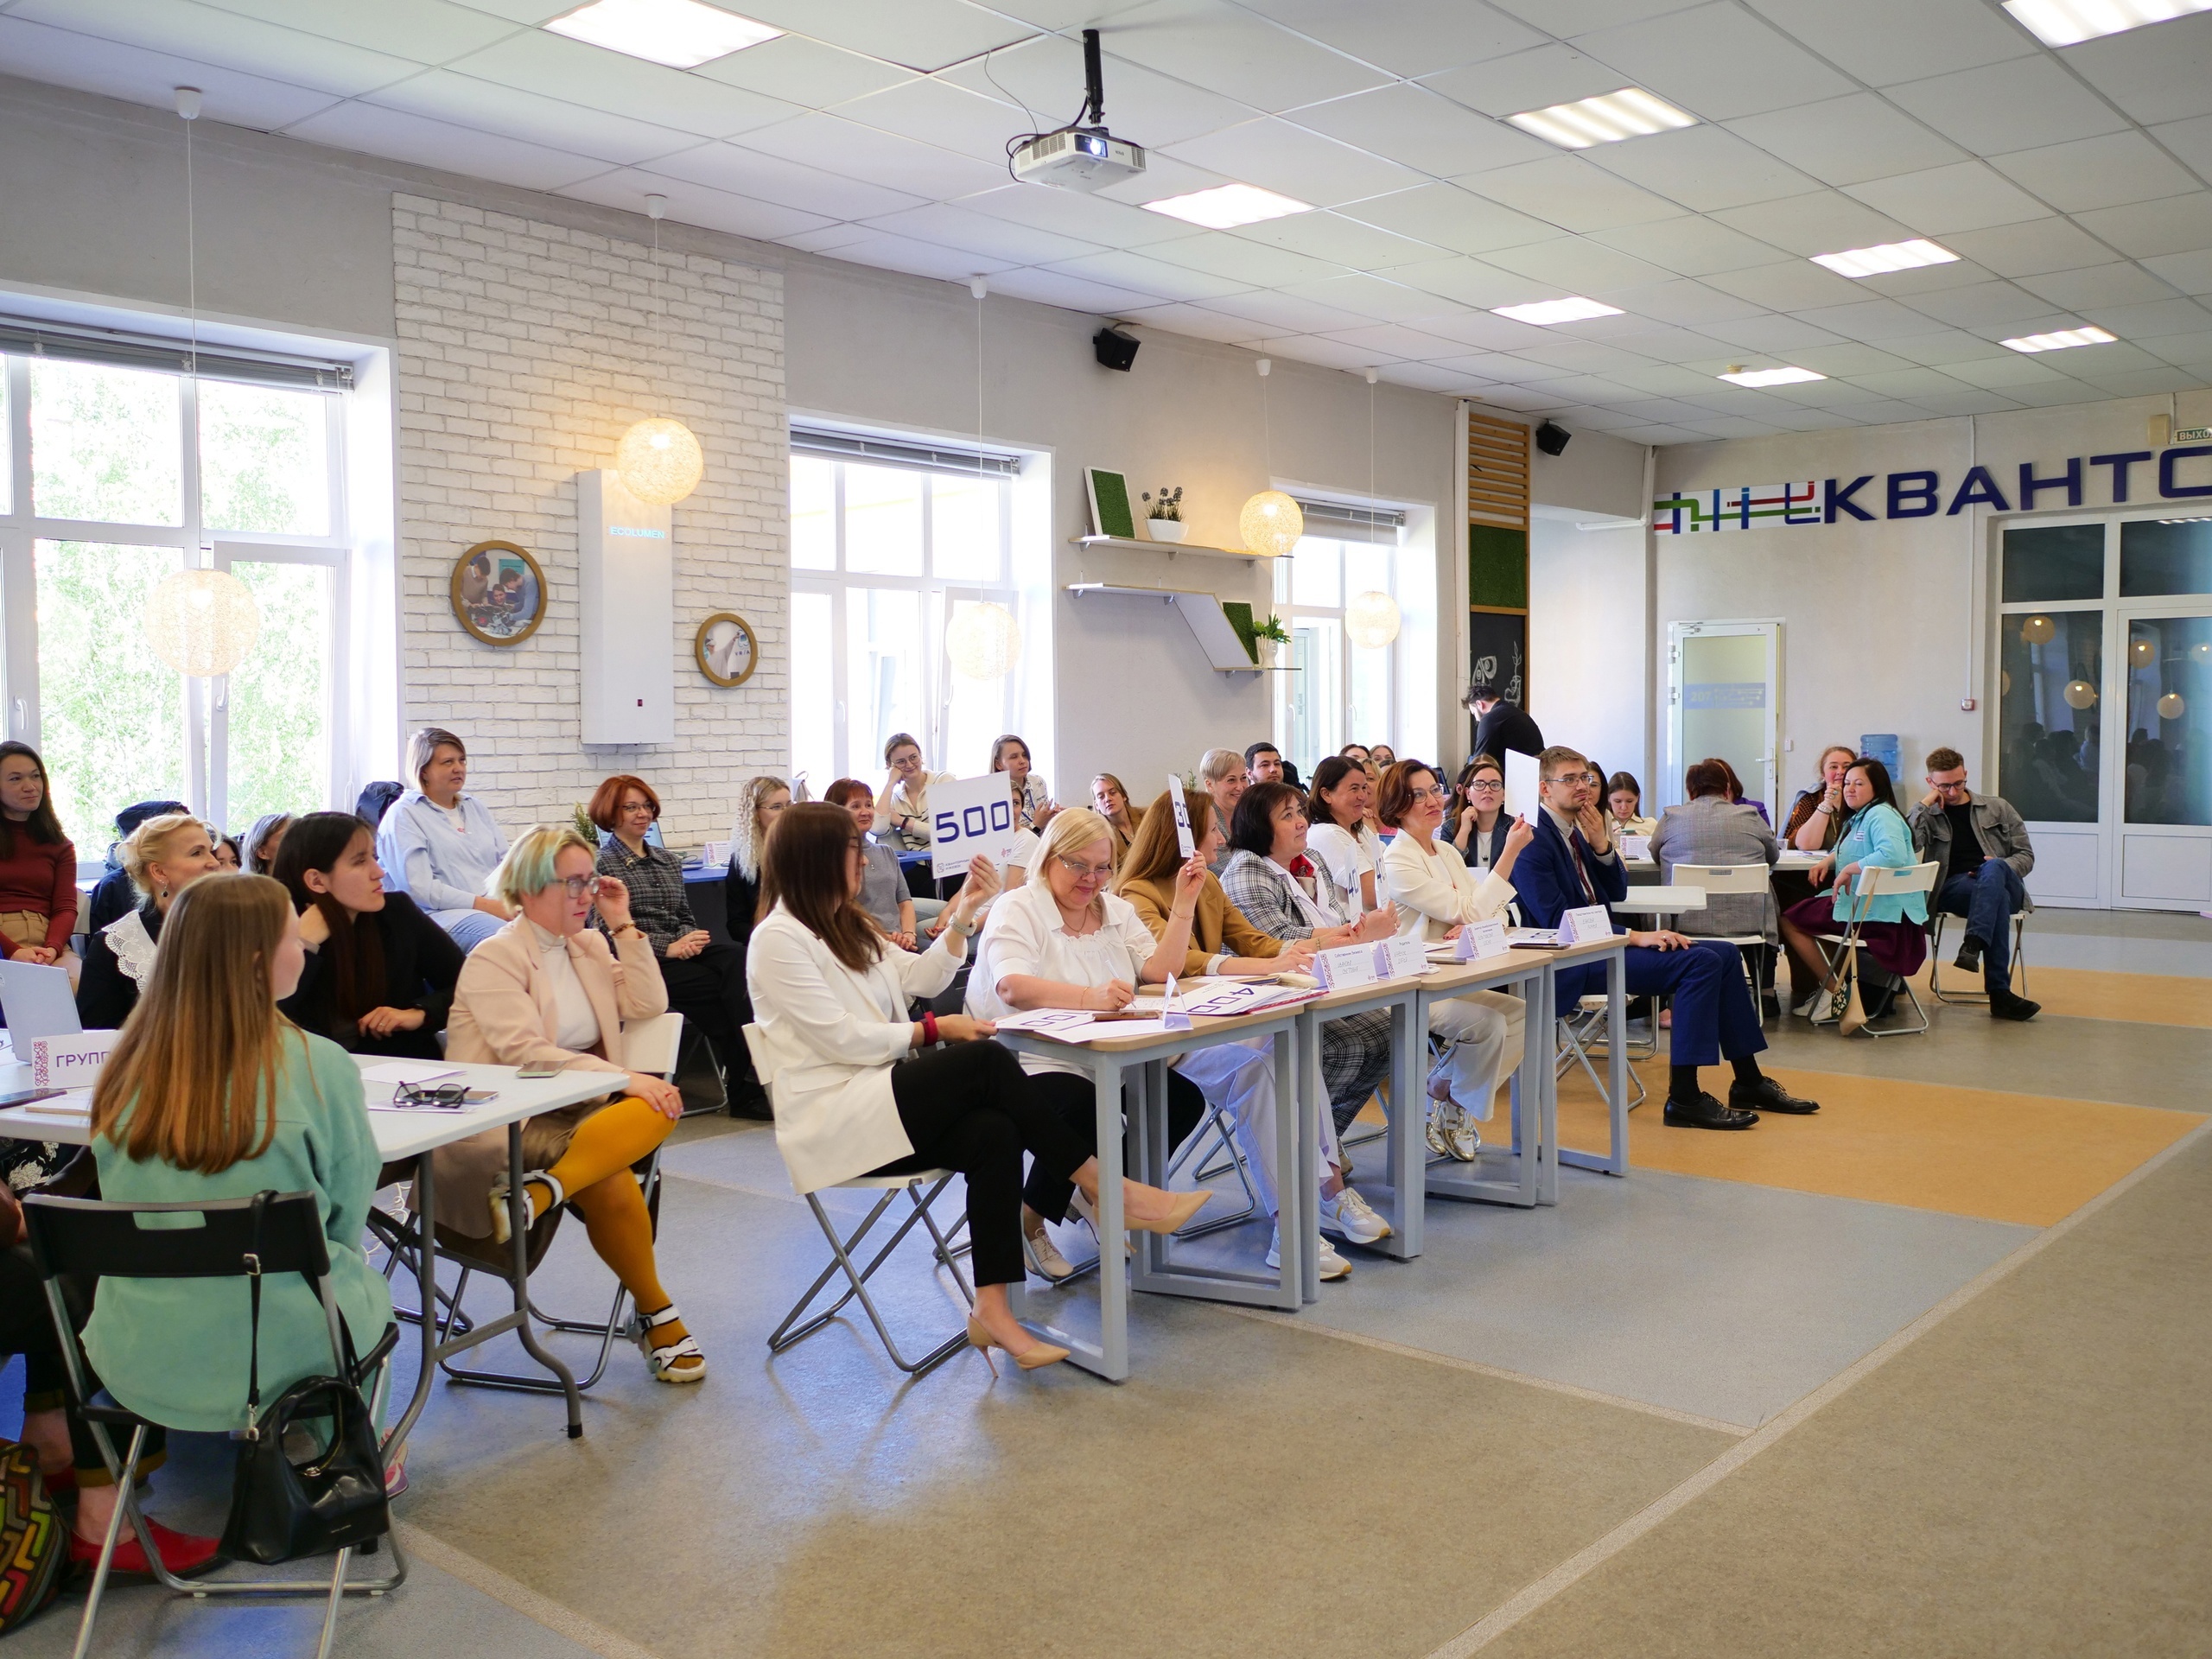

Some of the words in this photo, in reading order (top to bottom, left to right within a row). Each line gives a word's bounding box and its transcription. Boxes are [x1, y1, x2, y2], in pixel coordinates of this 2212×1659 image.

[1824, 446, 2212, 524] КВАНТО
[610, 526, 665, 539] ECOLUMEN
[936, 800, 1010, 843] 500
[1186, 988, 1255, 1013] 400
[56, 1051, 111, 1067] ГРУПП
